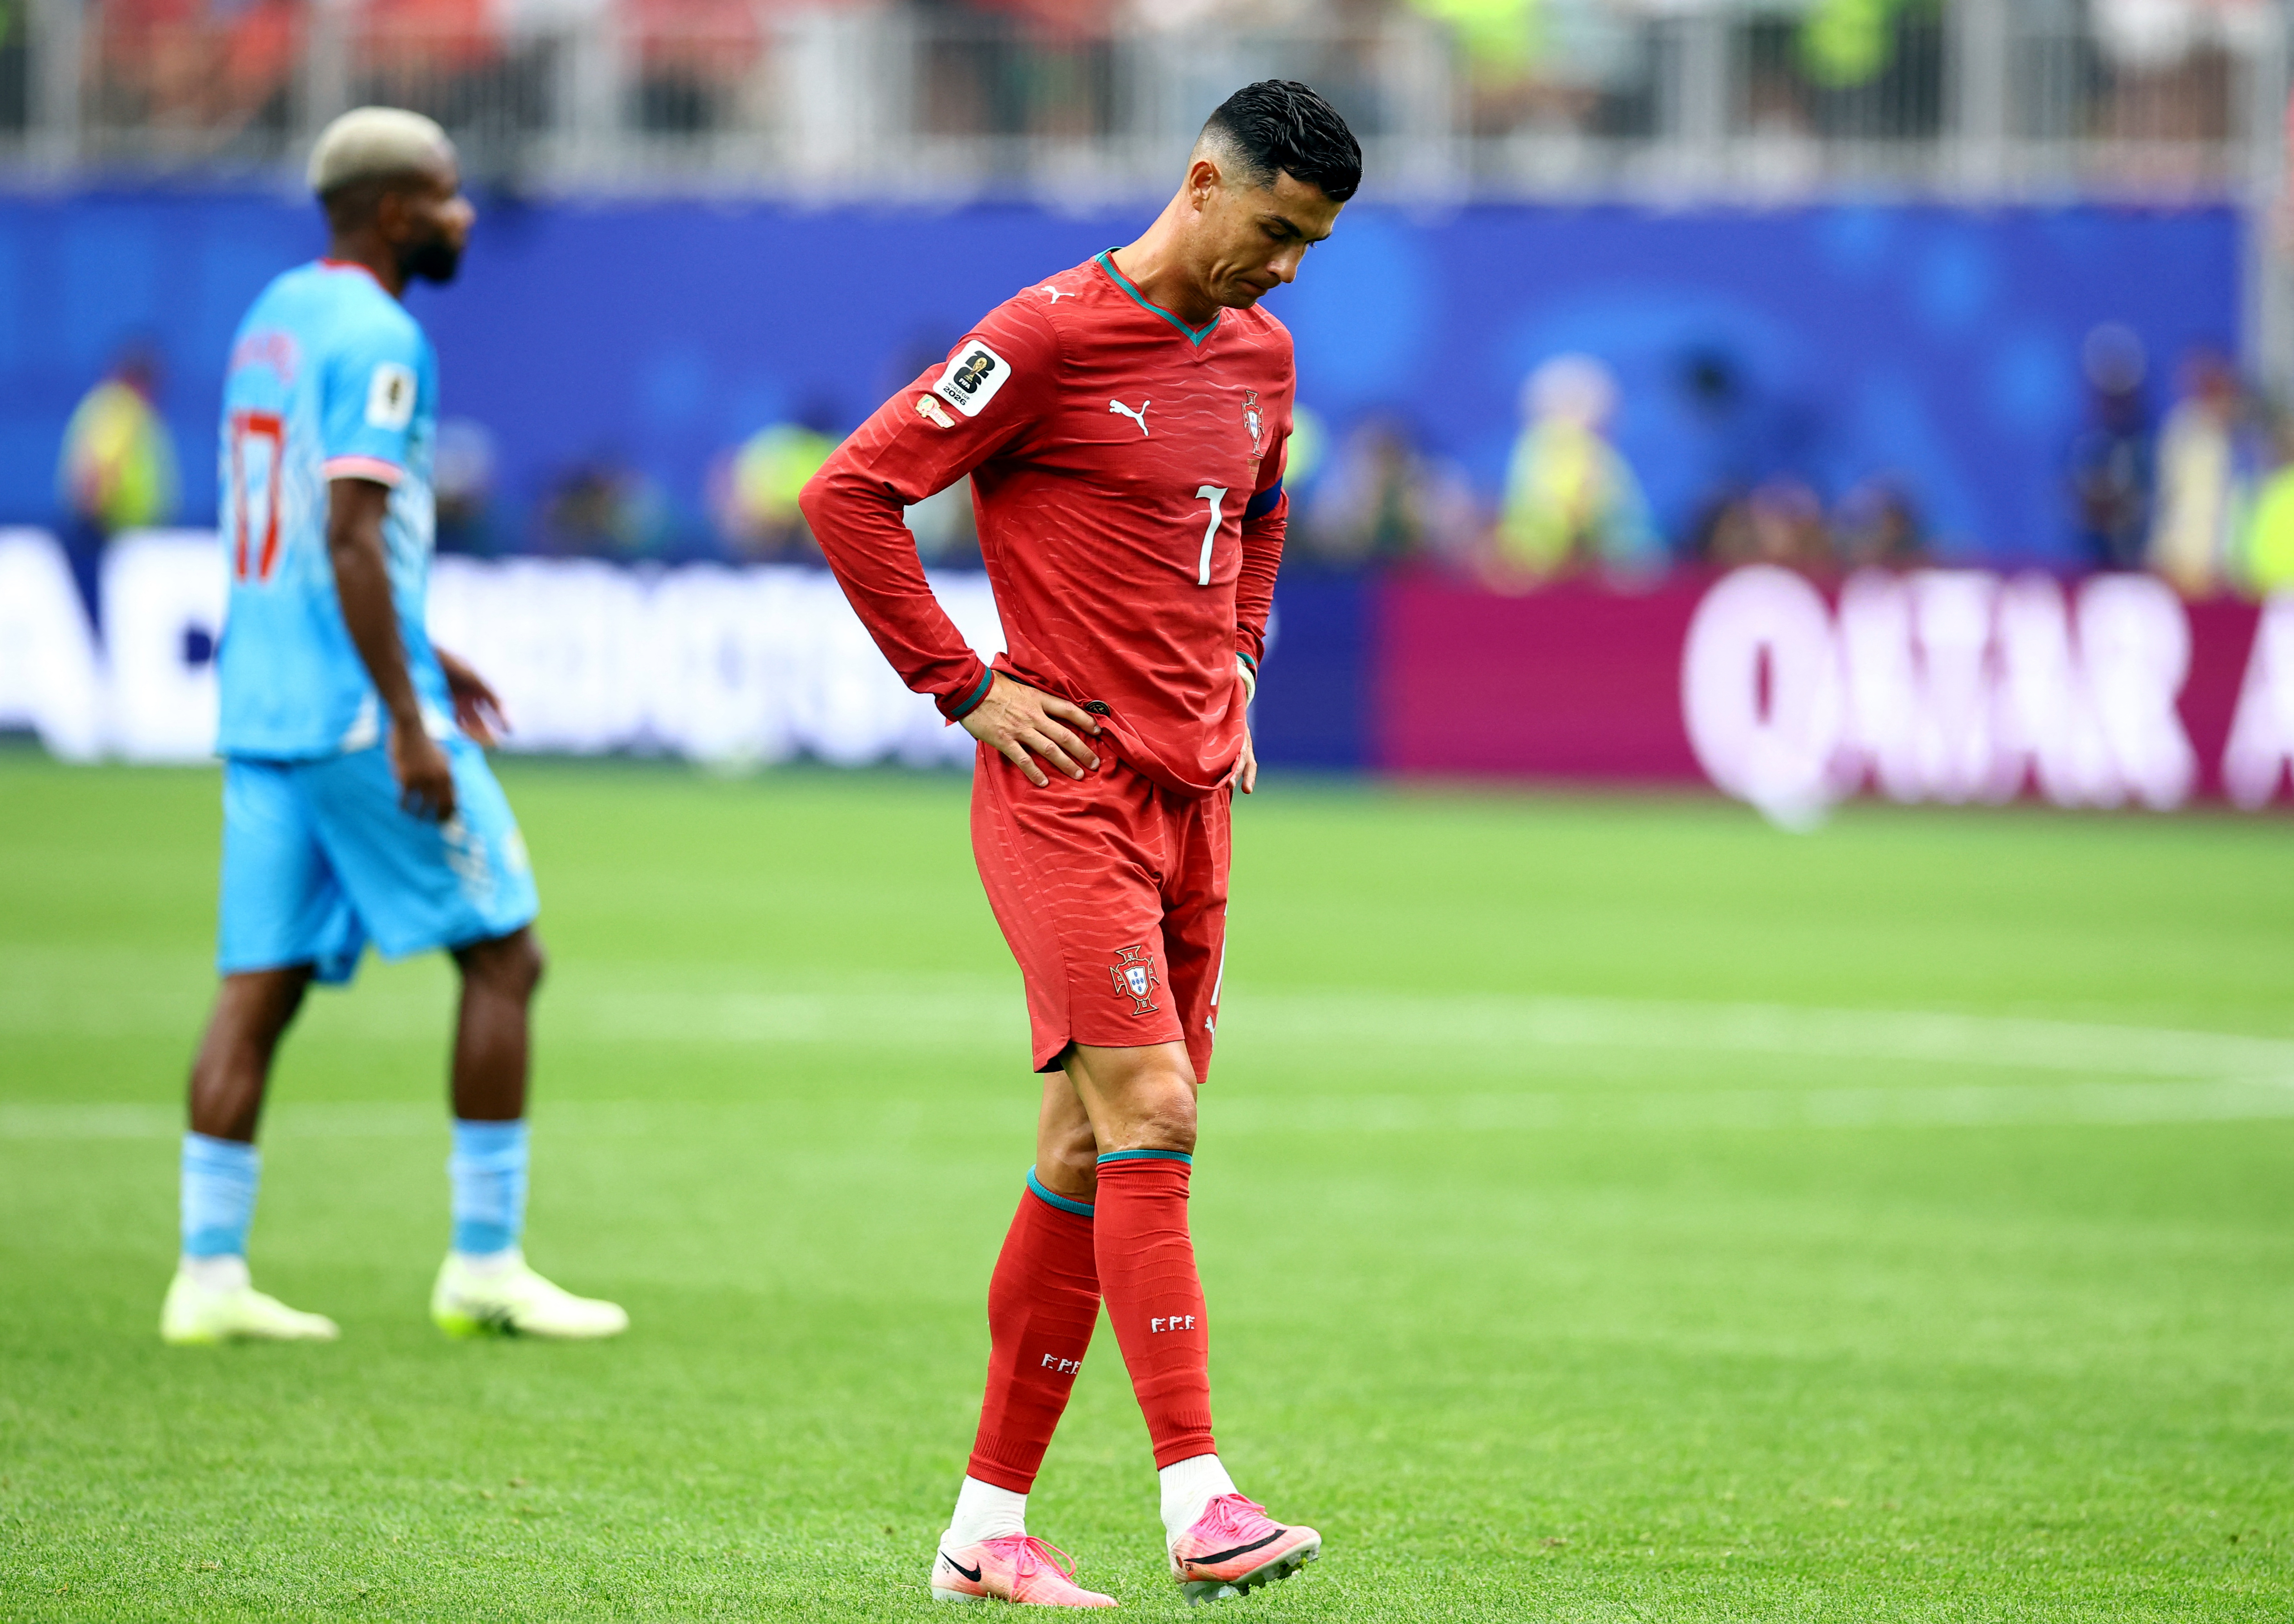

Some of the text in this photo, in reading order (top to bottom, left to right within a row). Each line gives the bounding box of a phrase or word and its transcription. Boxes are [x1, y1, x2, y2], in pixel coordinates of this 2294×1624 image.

[948, 382, 962, 394] WORLD
[958, 378, 971, 389] FIFA
[943, 386, 967, 406] 2026
[932, 411, 948, 425] LEGACY
[1195, 485, 1228, 585] 7
[1683, 564, 2197, 827] QATAR
[1151, 1315, 1195, 1333] F.P.F.
